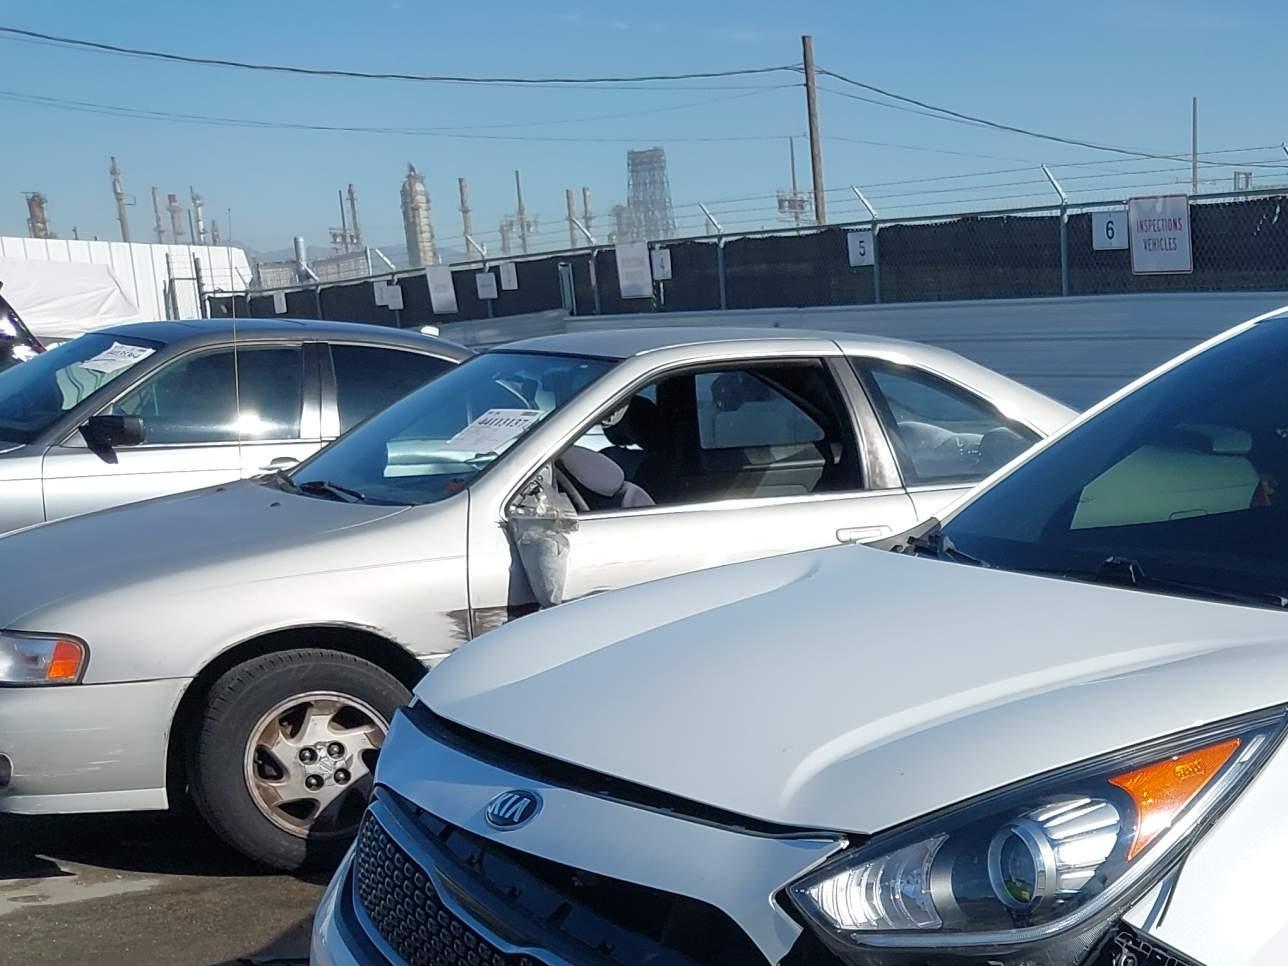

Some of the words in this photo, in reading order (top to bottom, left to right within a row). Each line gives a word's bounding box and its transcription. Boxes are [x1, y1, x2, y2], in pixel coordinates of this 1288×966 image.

[1105, 220, 1115, 240] 6
[1136, 217, 1183, 233] INSPECTIONS
[858, 240, 866, 257] 5
[1143, 237, 1177, 252] VEHICLES
[487, 793, 531, 823] KIA
